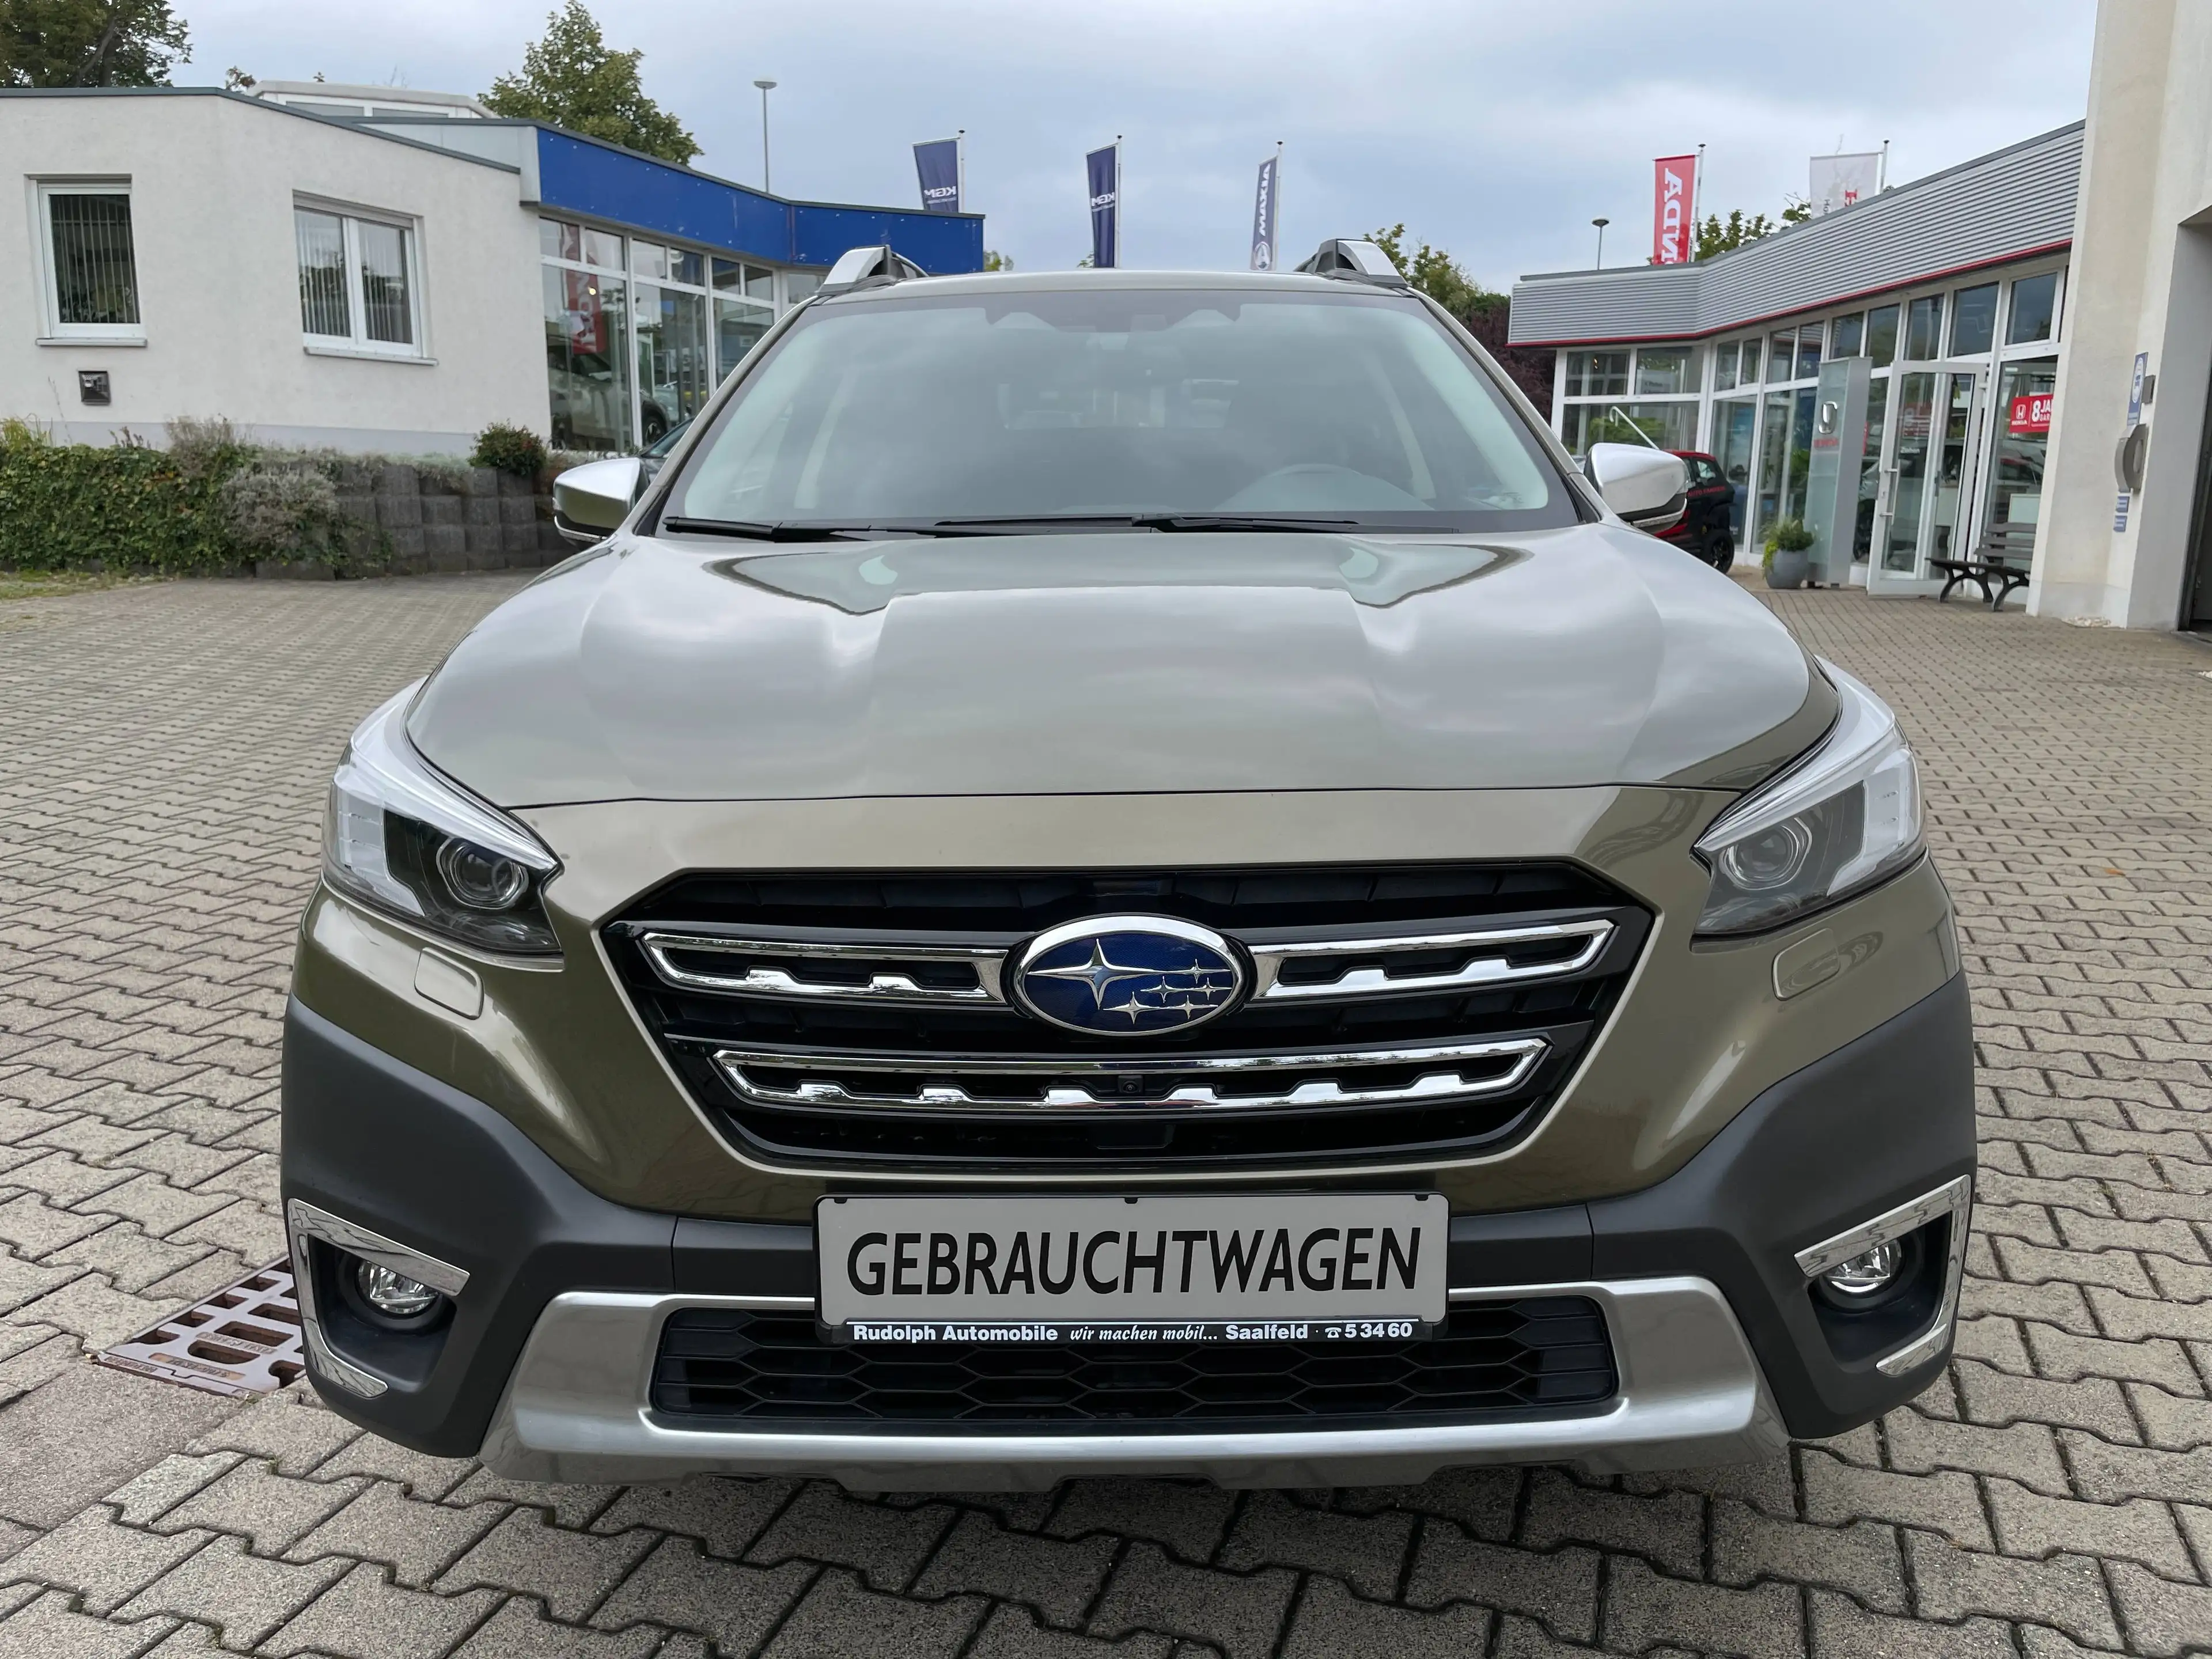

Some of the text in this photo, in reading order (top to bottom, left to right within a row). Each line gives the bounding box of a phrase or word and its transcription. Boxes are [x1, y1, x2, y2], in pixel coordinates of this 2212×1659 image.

[2032, 399, 2051, 422] 8 JA
[847, 1227, 1421, 1295] GEBRAUCHTWAGEN
[854, 1325, 935, 1343] Rudolph
[942, 1325, 1058, 1341] Automobile
[1070, 1326, 1094, 1340] wir
[1099, 1326, 1157, 1341] machen
[1225, 1324, 1308, 1340] Saalfeld
